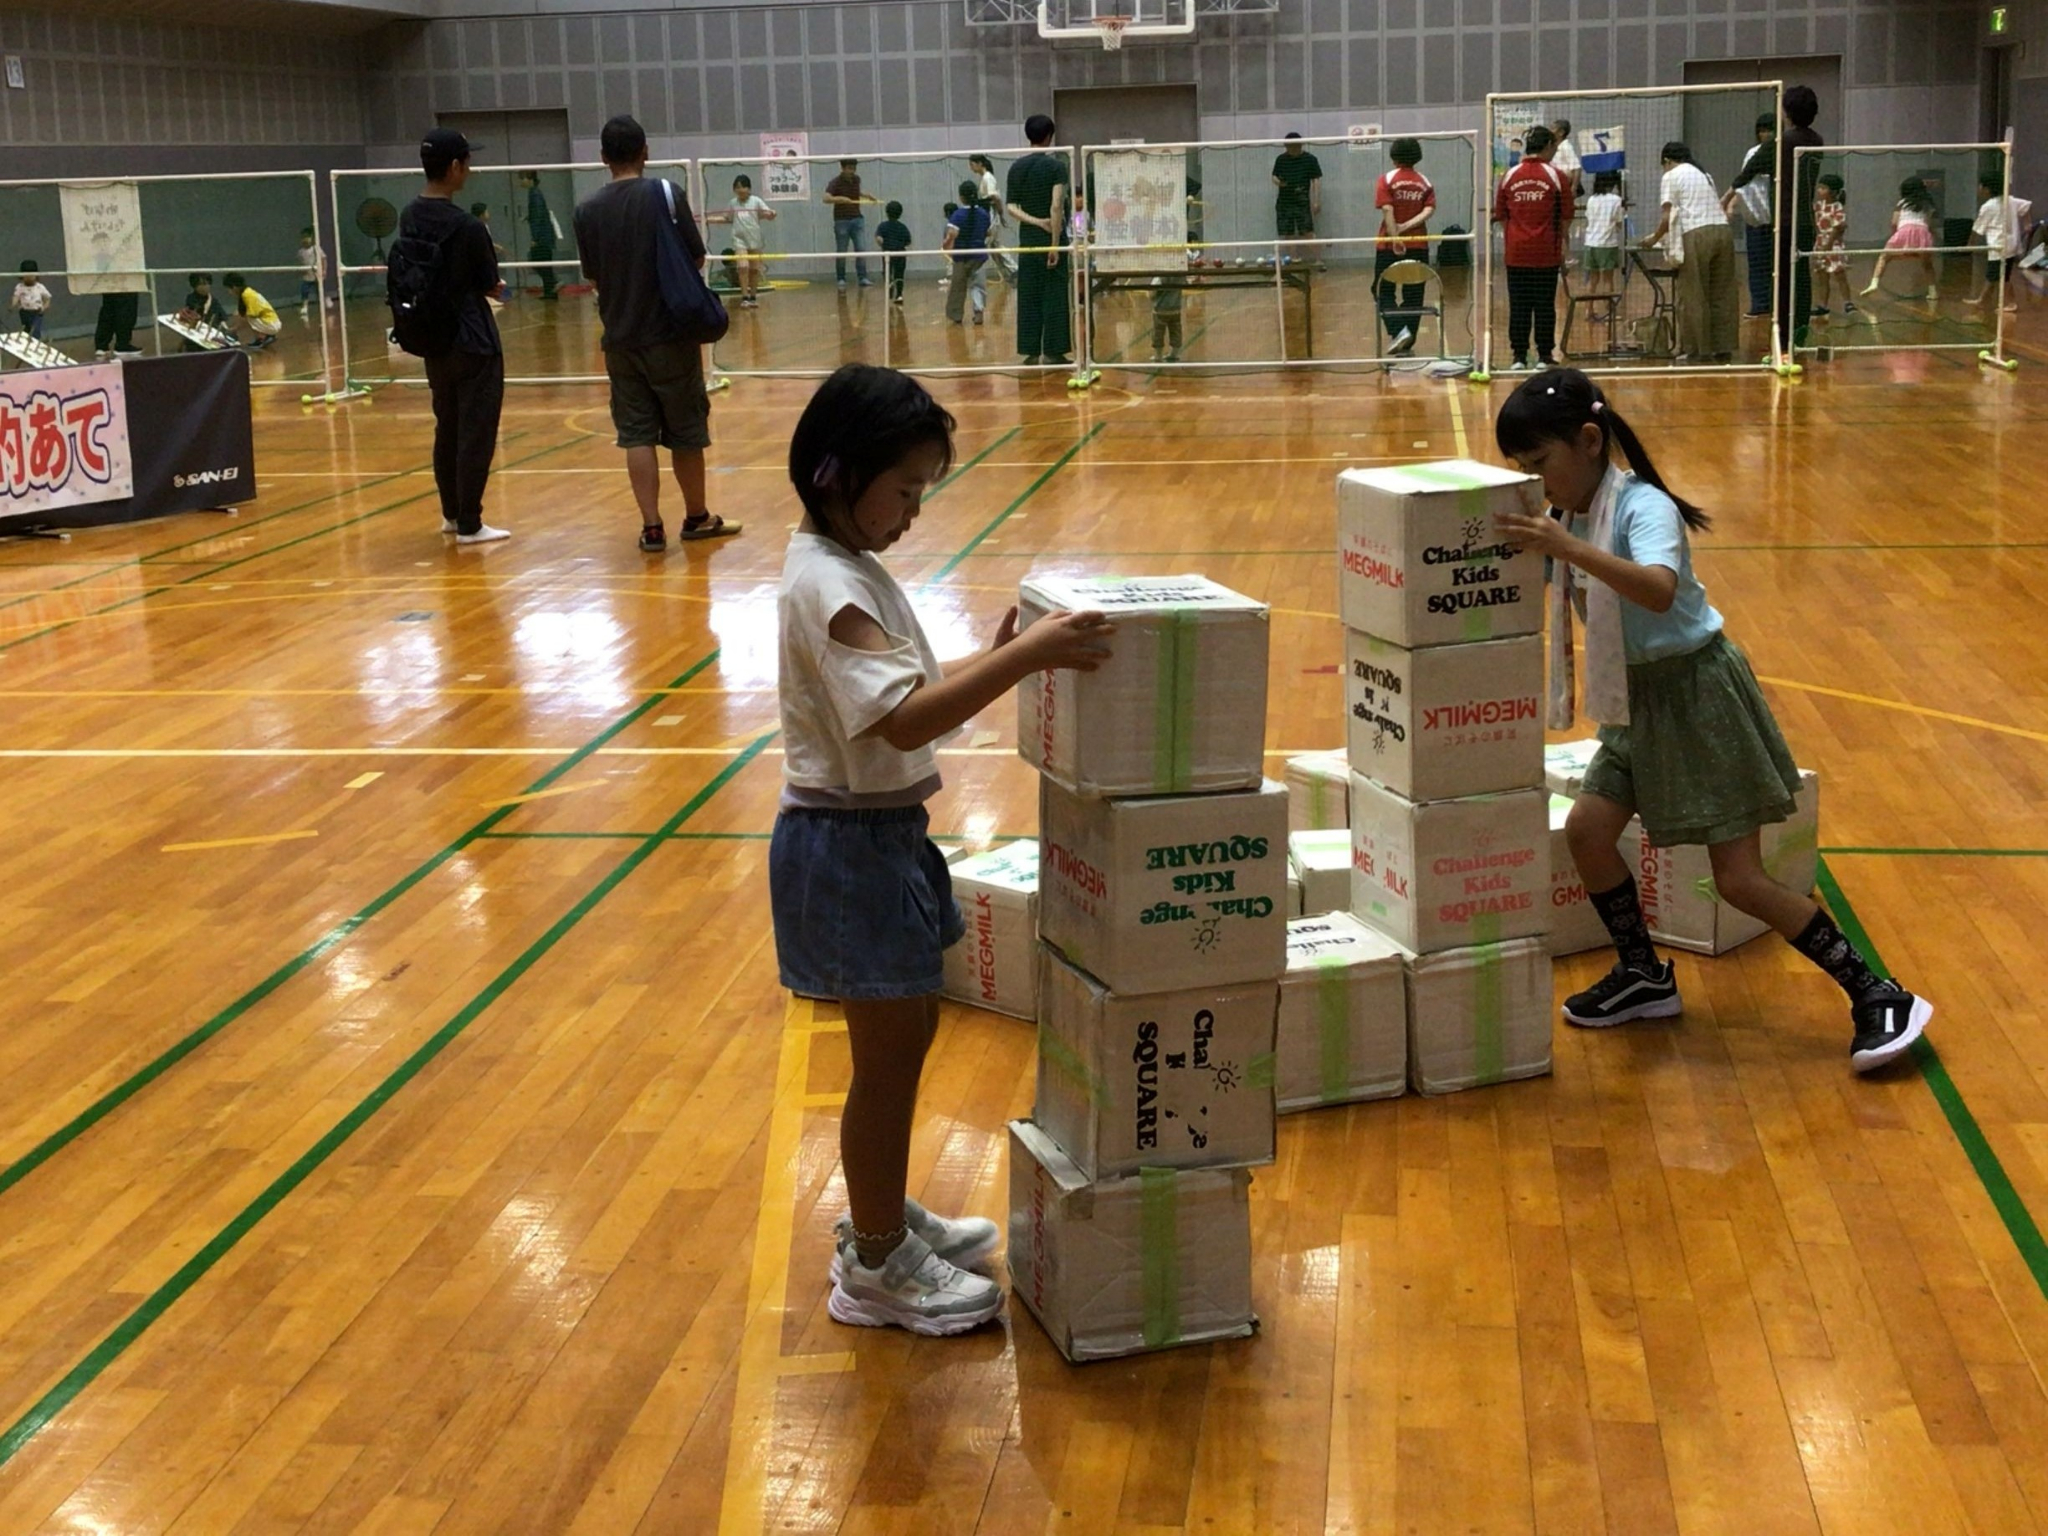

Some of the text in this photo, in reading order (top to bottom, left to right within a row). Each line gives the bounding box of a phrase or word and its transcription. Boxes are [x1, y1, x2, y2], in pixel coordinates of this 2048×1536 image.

[1396, 190, 1424, 201] STAFF
[1513, 190, 1546, 202] STAFF
[1343, 549, 1404, 588] MEGMILK
[1452, 566, 1500, 587] Kids
[1427, 585, 1521, 614] SQUARE
[1353, 658, 1403, 695] SQUARE
[1423, 697, 1537, 731] MEGMILK
[1043, 836, 1108, 900] MEGMILK
[1145, 835, 1269, 871] SQUARE
[1172, 870, 1236, 895] Kids
[1354, 845, 1408, 900] MEILK
[1464, 872, 1512, 895] Kids
[1140, 896, 1274, 926] Change
[1438, 891, 1533, 923] SQUARE
[976, 891, 997, 1002] MEGMILK
[1133, 1021, 1159, 1151] SQUARE
